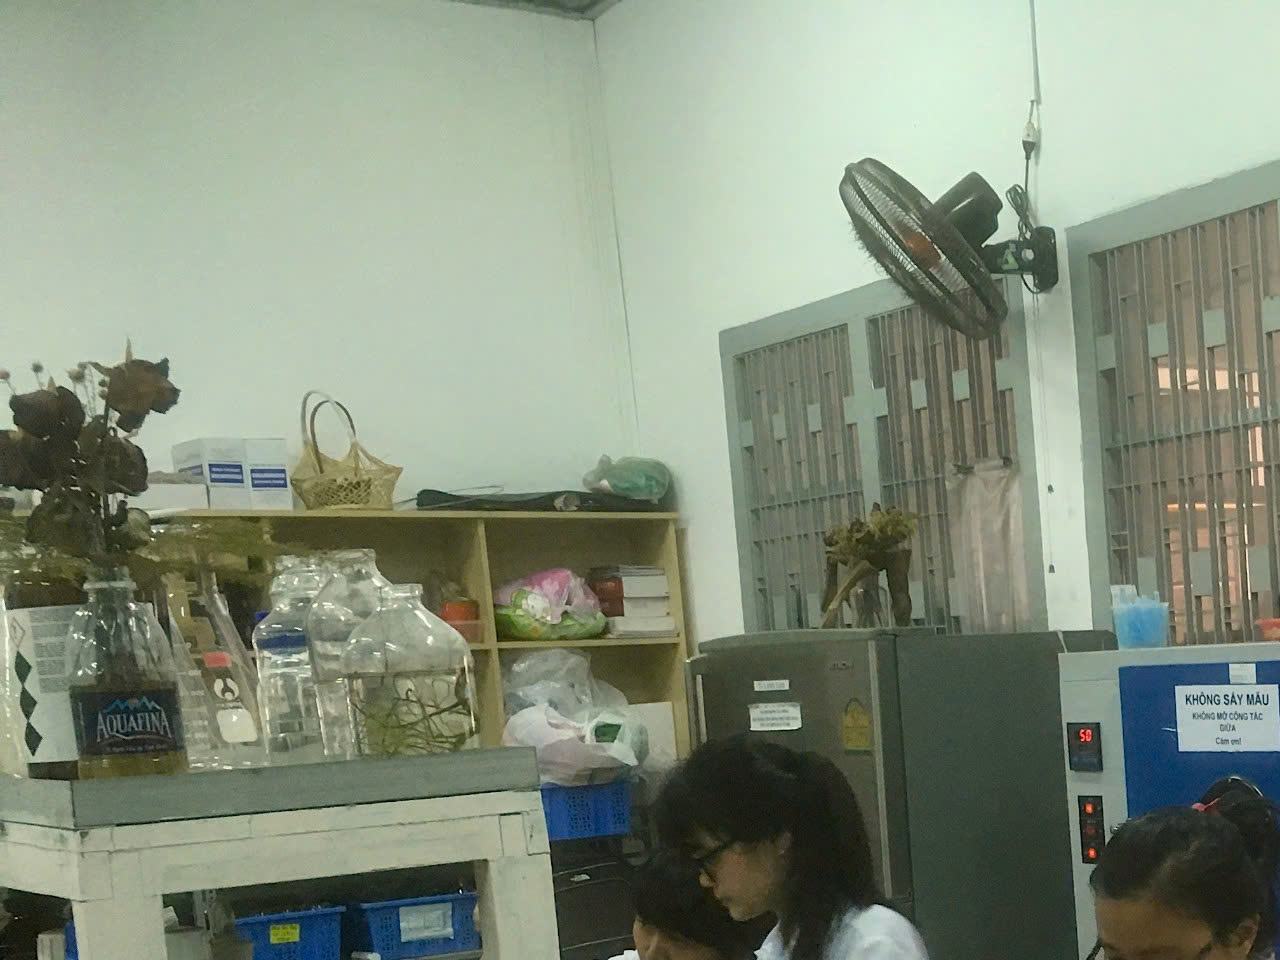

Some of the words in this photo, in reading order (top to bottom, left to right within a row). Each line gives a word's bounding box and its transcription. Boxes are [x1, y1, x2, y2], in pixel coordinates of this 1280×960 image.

[1185, 691, 1221, 706] KHÔNG
[1223, 691, 1244, 706] SẤY
[1246, 691, 1270, 706] MẪU
[1192, 711, 1216, 721] KHÔNG
[1229, 711, 1249, 721] CÔNG
[97, 708, 172, 743] AQUAFINA
[1079, 729, 1093, 742] 50
